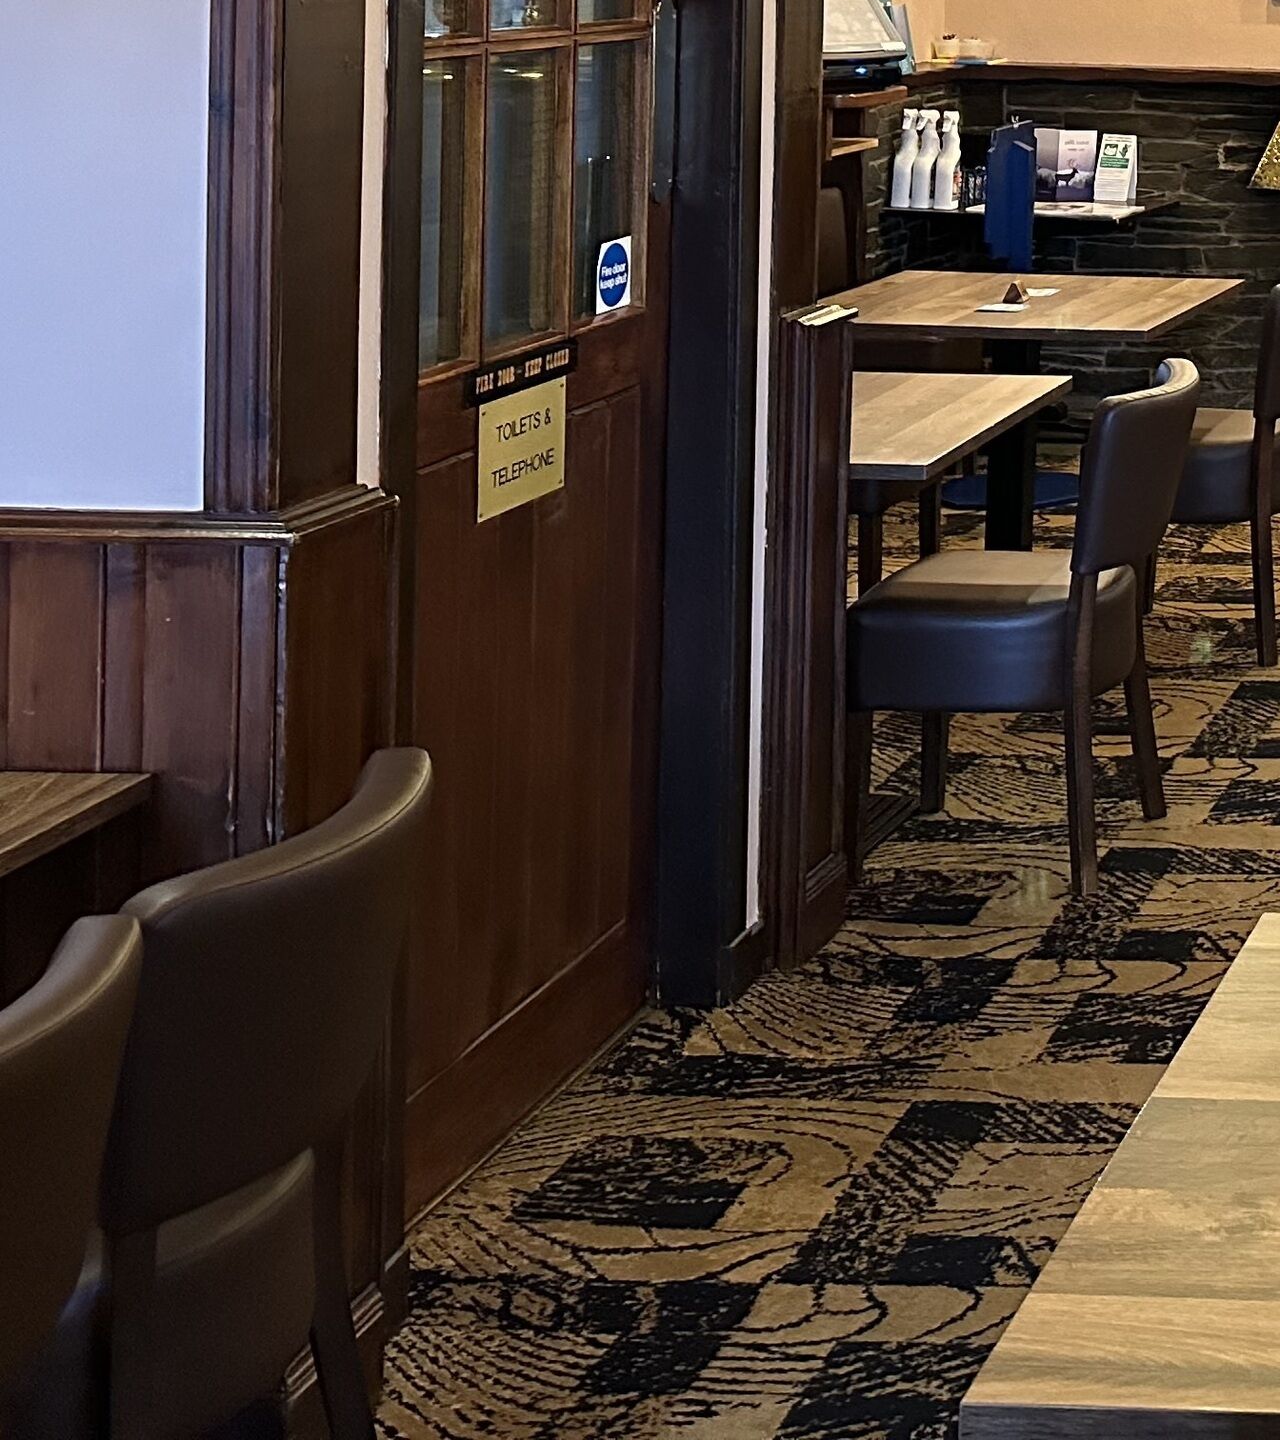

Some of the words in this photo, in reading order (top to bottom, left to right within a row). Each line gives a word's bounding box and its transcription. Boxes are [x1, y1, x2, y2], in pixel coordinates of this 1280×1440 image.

[601, 265, 613, 278] Fire
[496, 411, 541, 443] TOILETS
[544, 407, 552, 426] &
[491, 447, 555, 489] TELEPHONE
